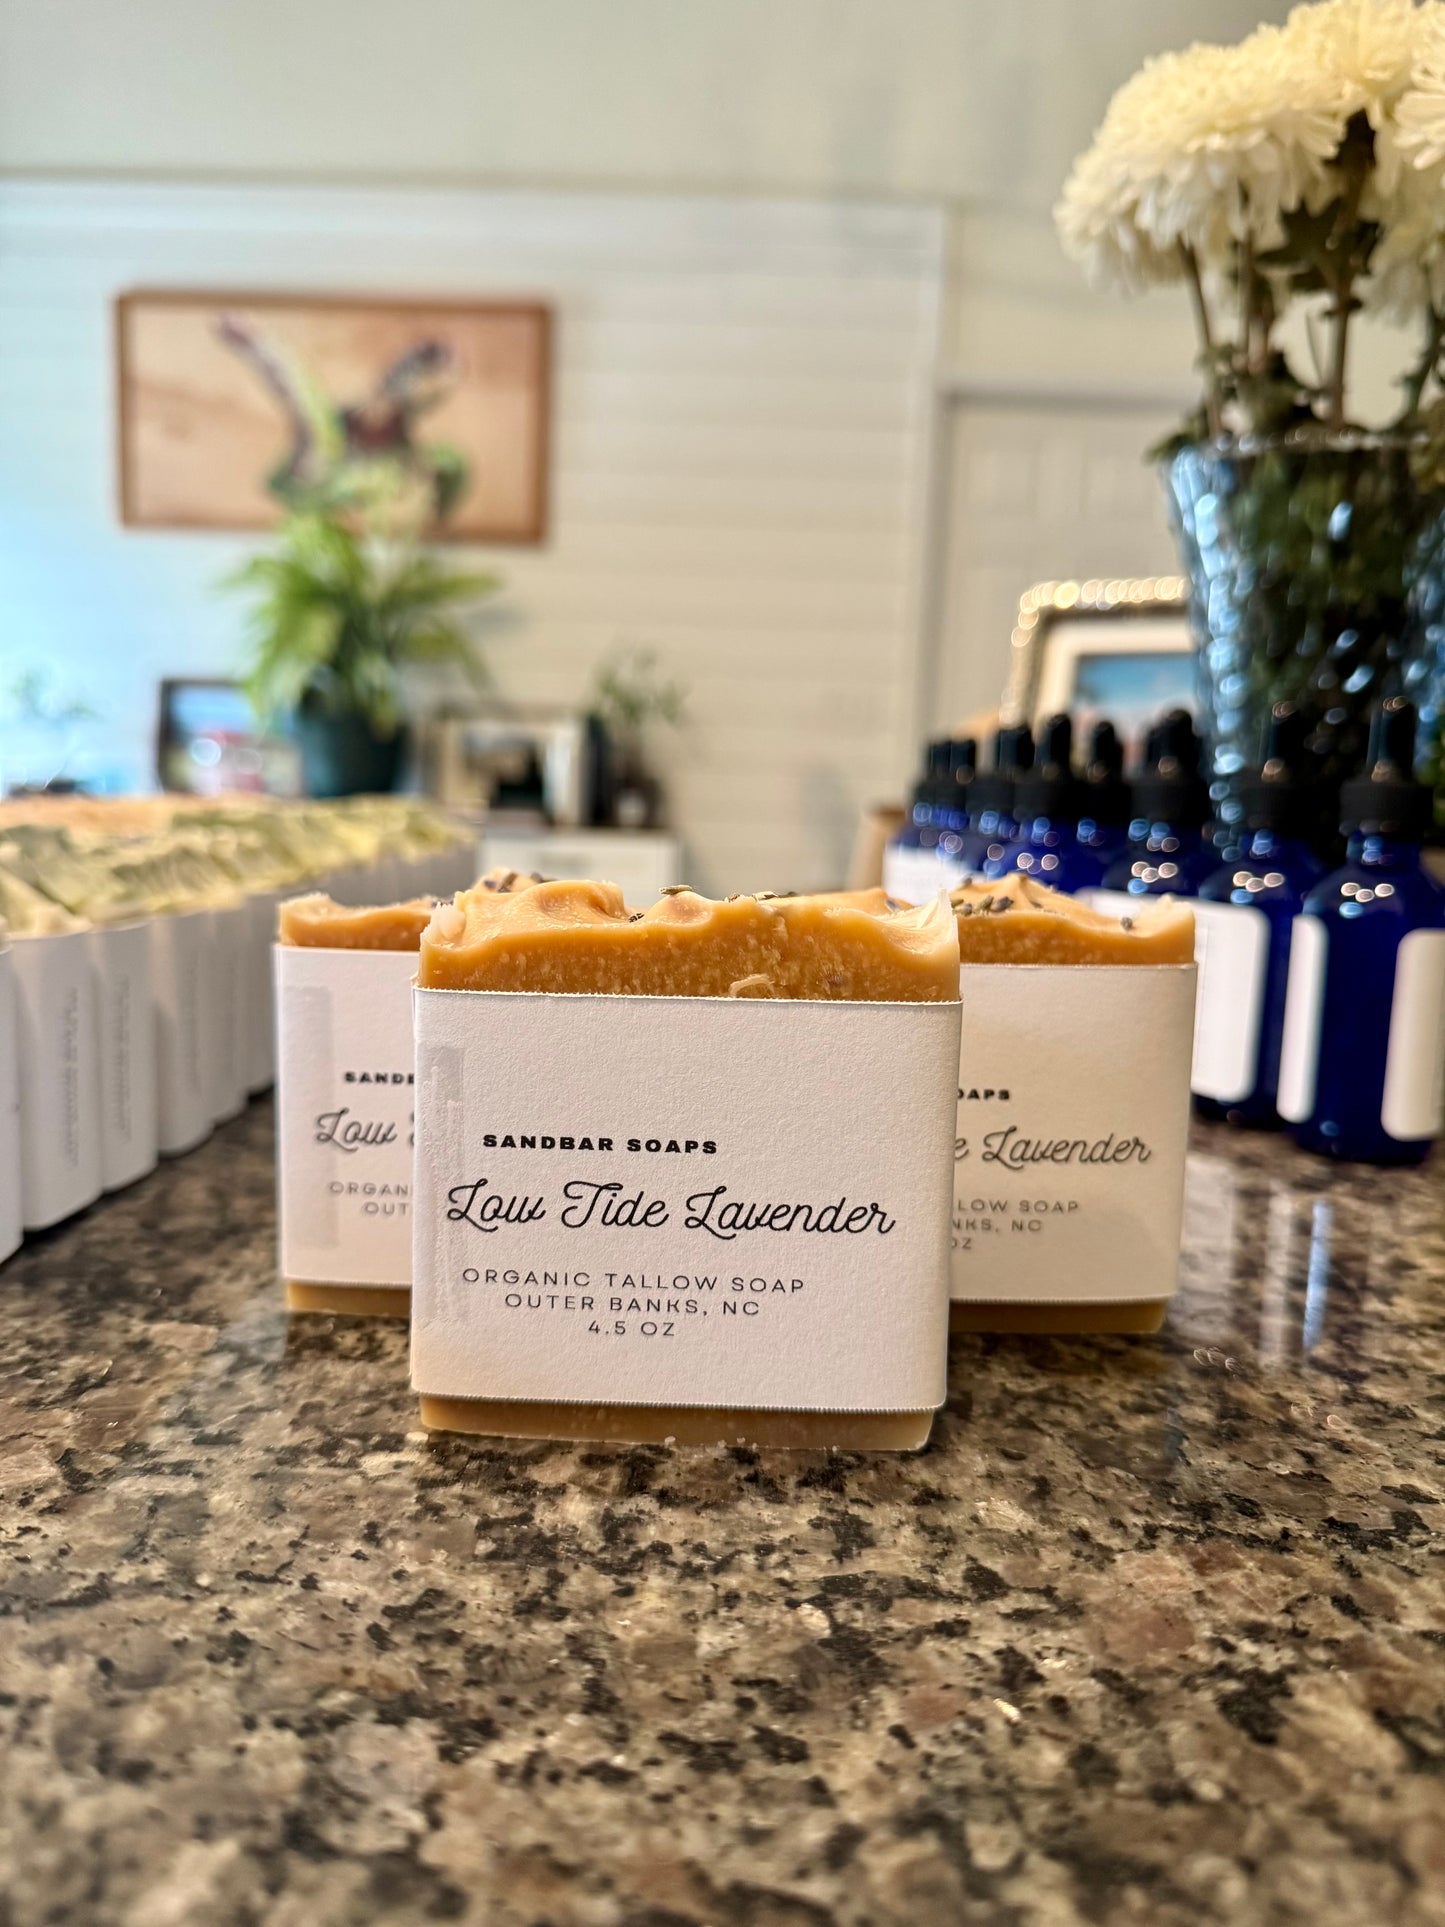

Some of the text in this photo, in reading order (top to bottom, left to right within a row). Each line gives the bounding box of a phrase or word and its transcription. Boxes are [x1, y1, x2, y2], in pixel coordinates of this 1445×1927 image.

[315, 1107, 399, 1154] Low
[483, 1134, 718, 1155] SANDBAR SOAPS
[981, 1124, 1152, 1172] Lavender
[445, 1177, 897, 1241] Low Tide Lavender
[1018, 1200, 1080, 1215] SOAP
[1011, 1219, 1043, 1233] NC
[462, 1268, 804, 1294] ORGANIC TALLOW SOAP
[504, 1294, 760, 1317] OUTER BANKS, NC
[587, 1320, 676, 1338] 4.5 OZ
